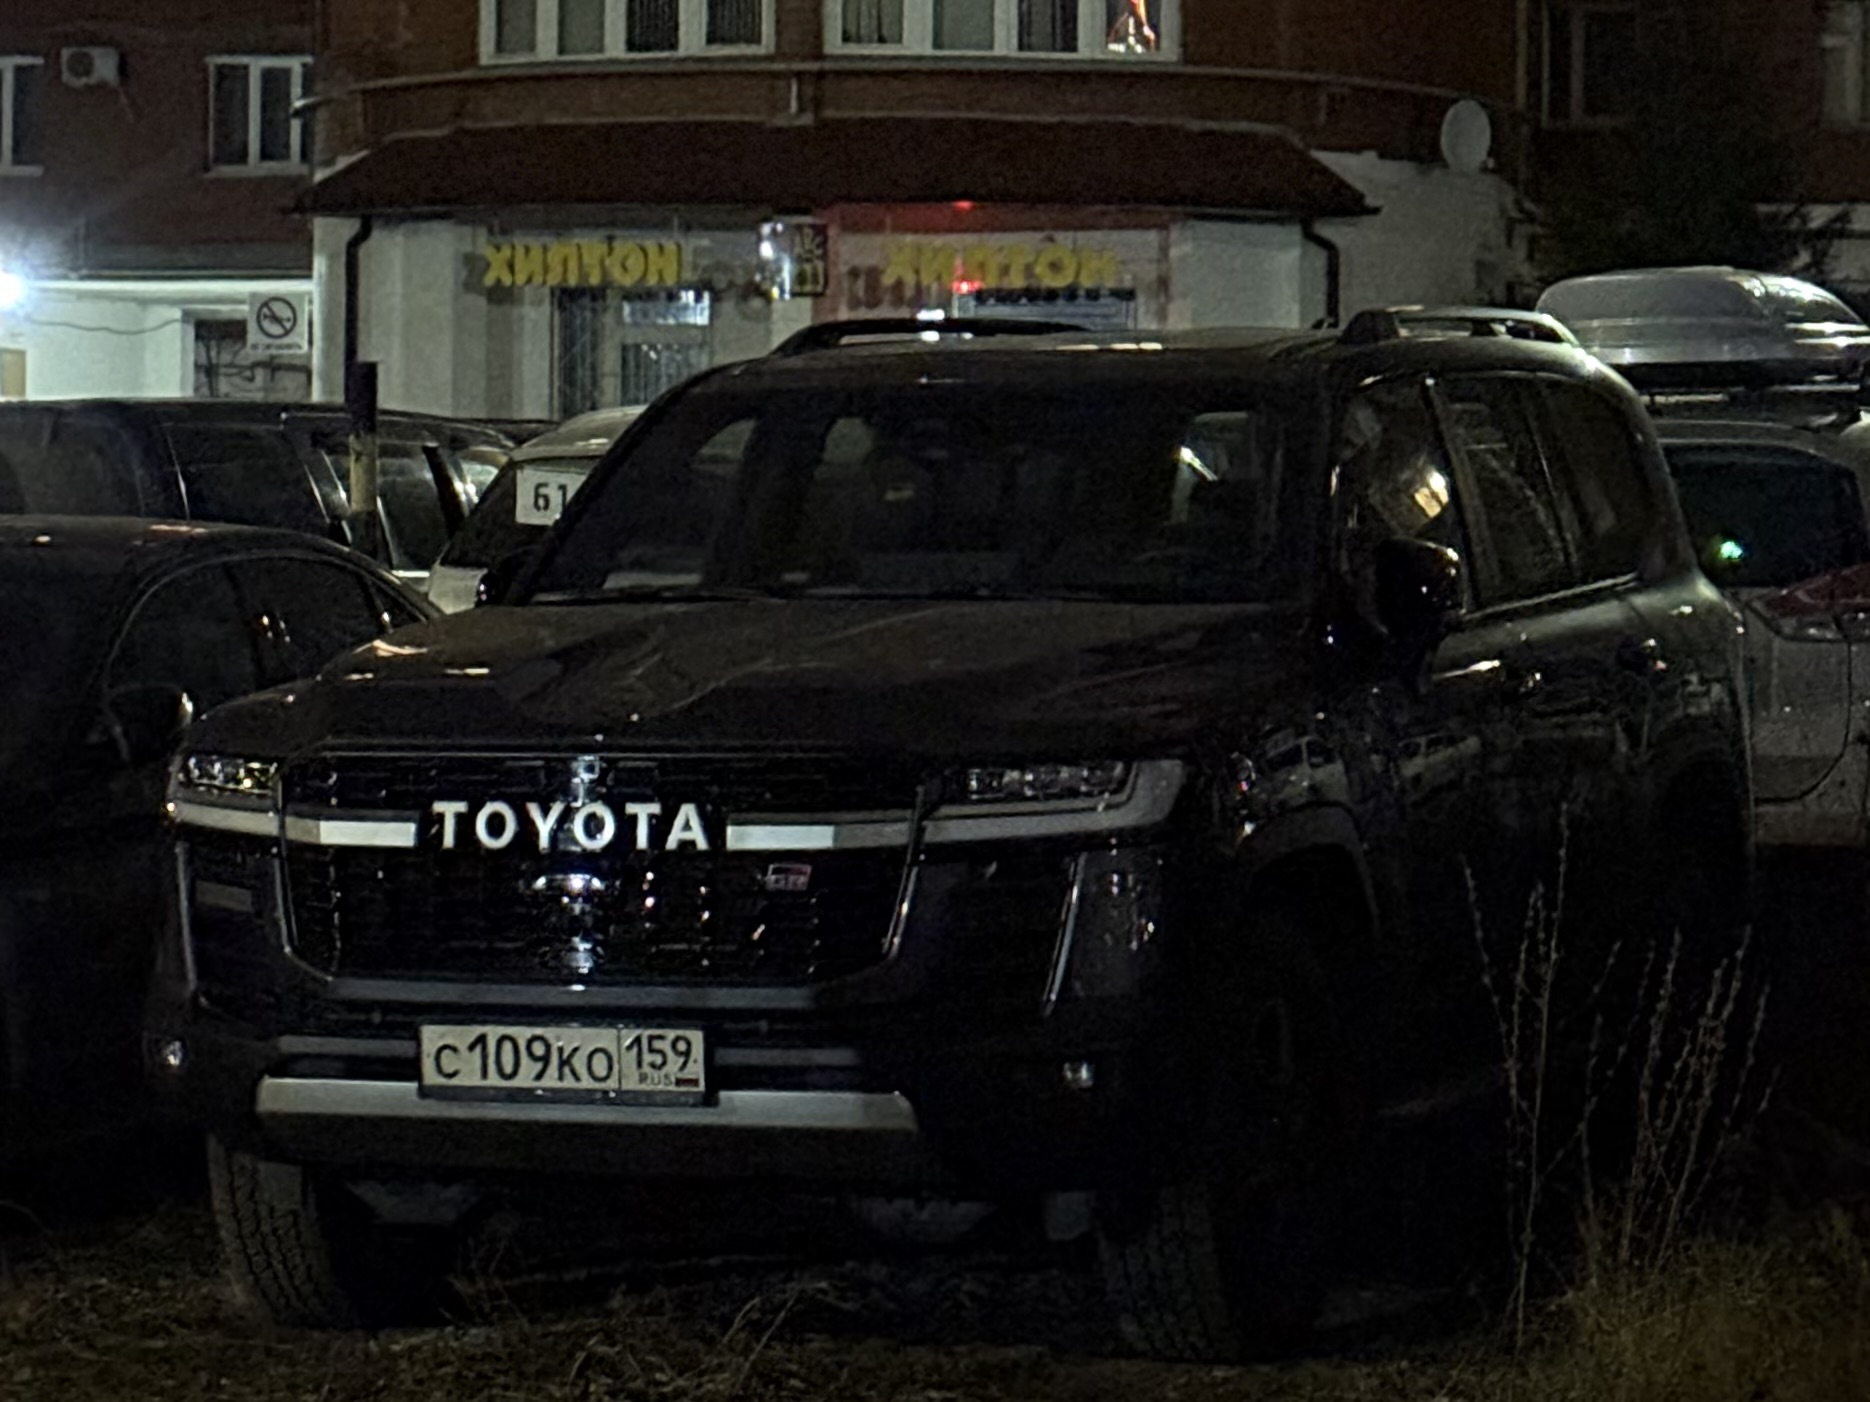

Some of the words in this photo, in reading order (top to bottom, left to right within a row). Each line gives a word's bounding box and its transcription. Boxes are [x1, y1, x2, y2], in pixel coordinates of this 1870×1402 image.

[484, 240, 682, 287] ХИЛТОН
[882, 240, 1120, 288] ХИЛТОН
[533, 482, 567, 513] 61
[432, 801, 710, 850] TOYOTA
[624, 1034, 692, 1072] 159
[639, 1072, 673, 1086] RUS
